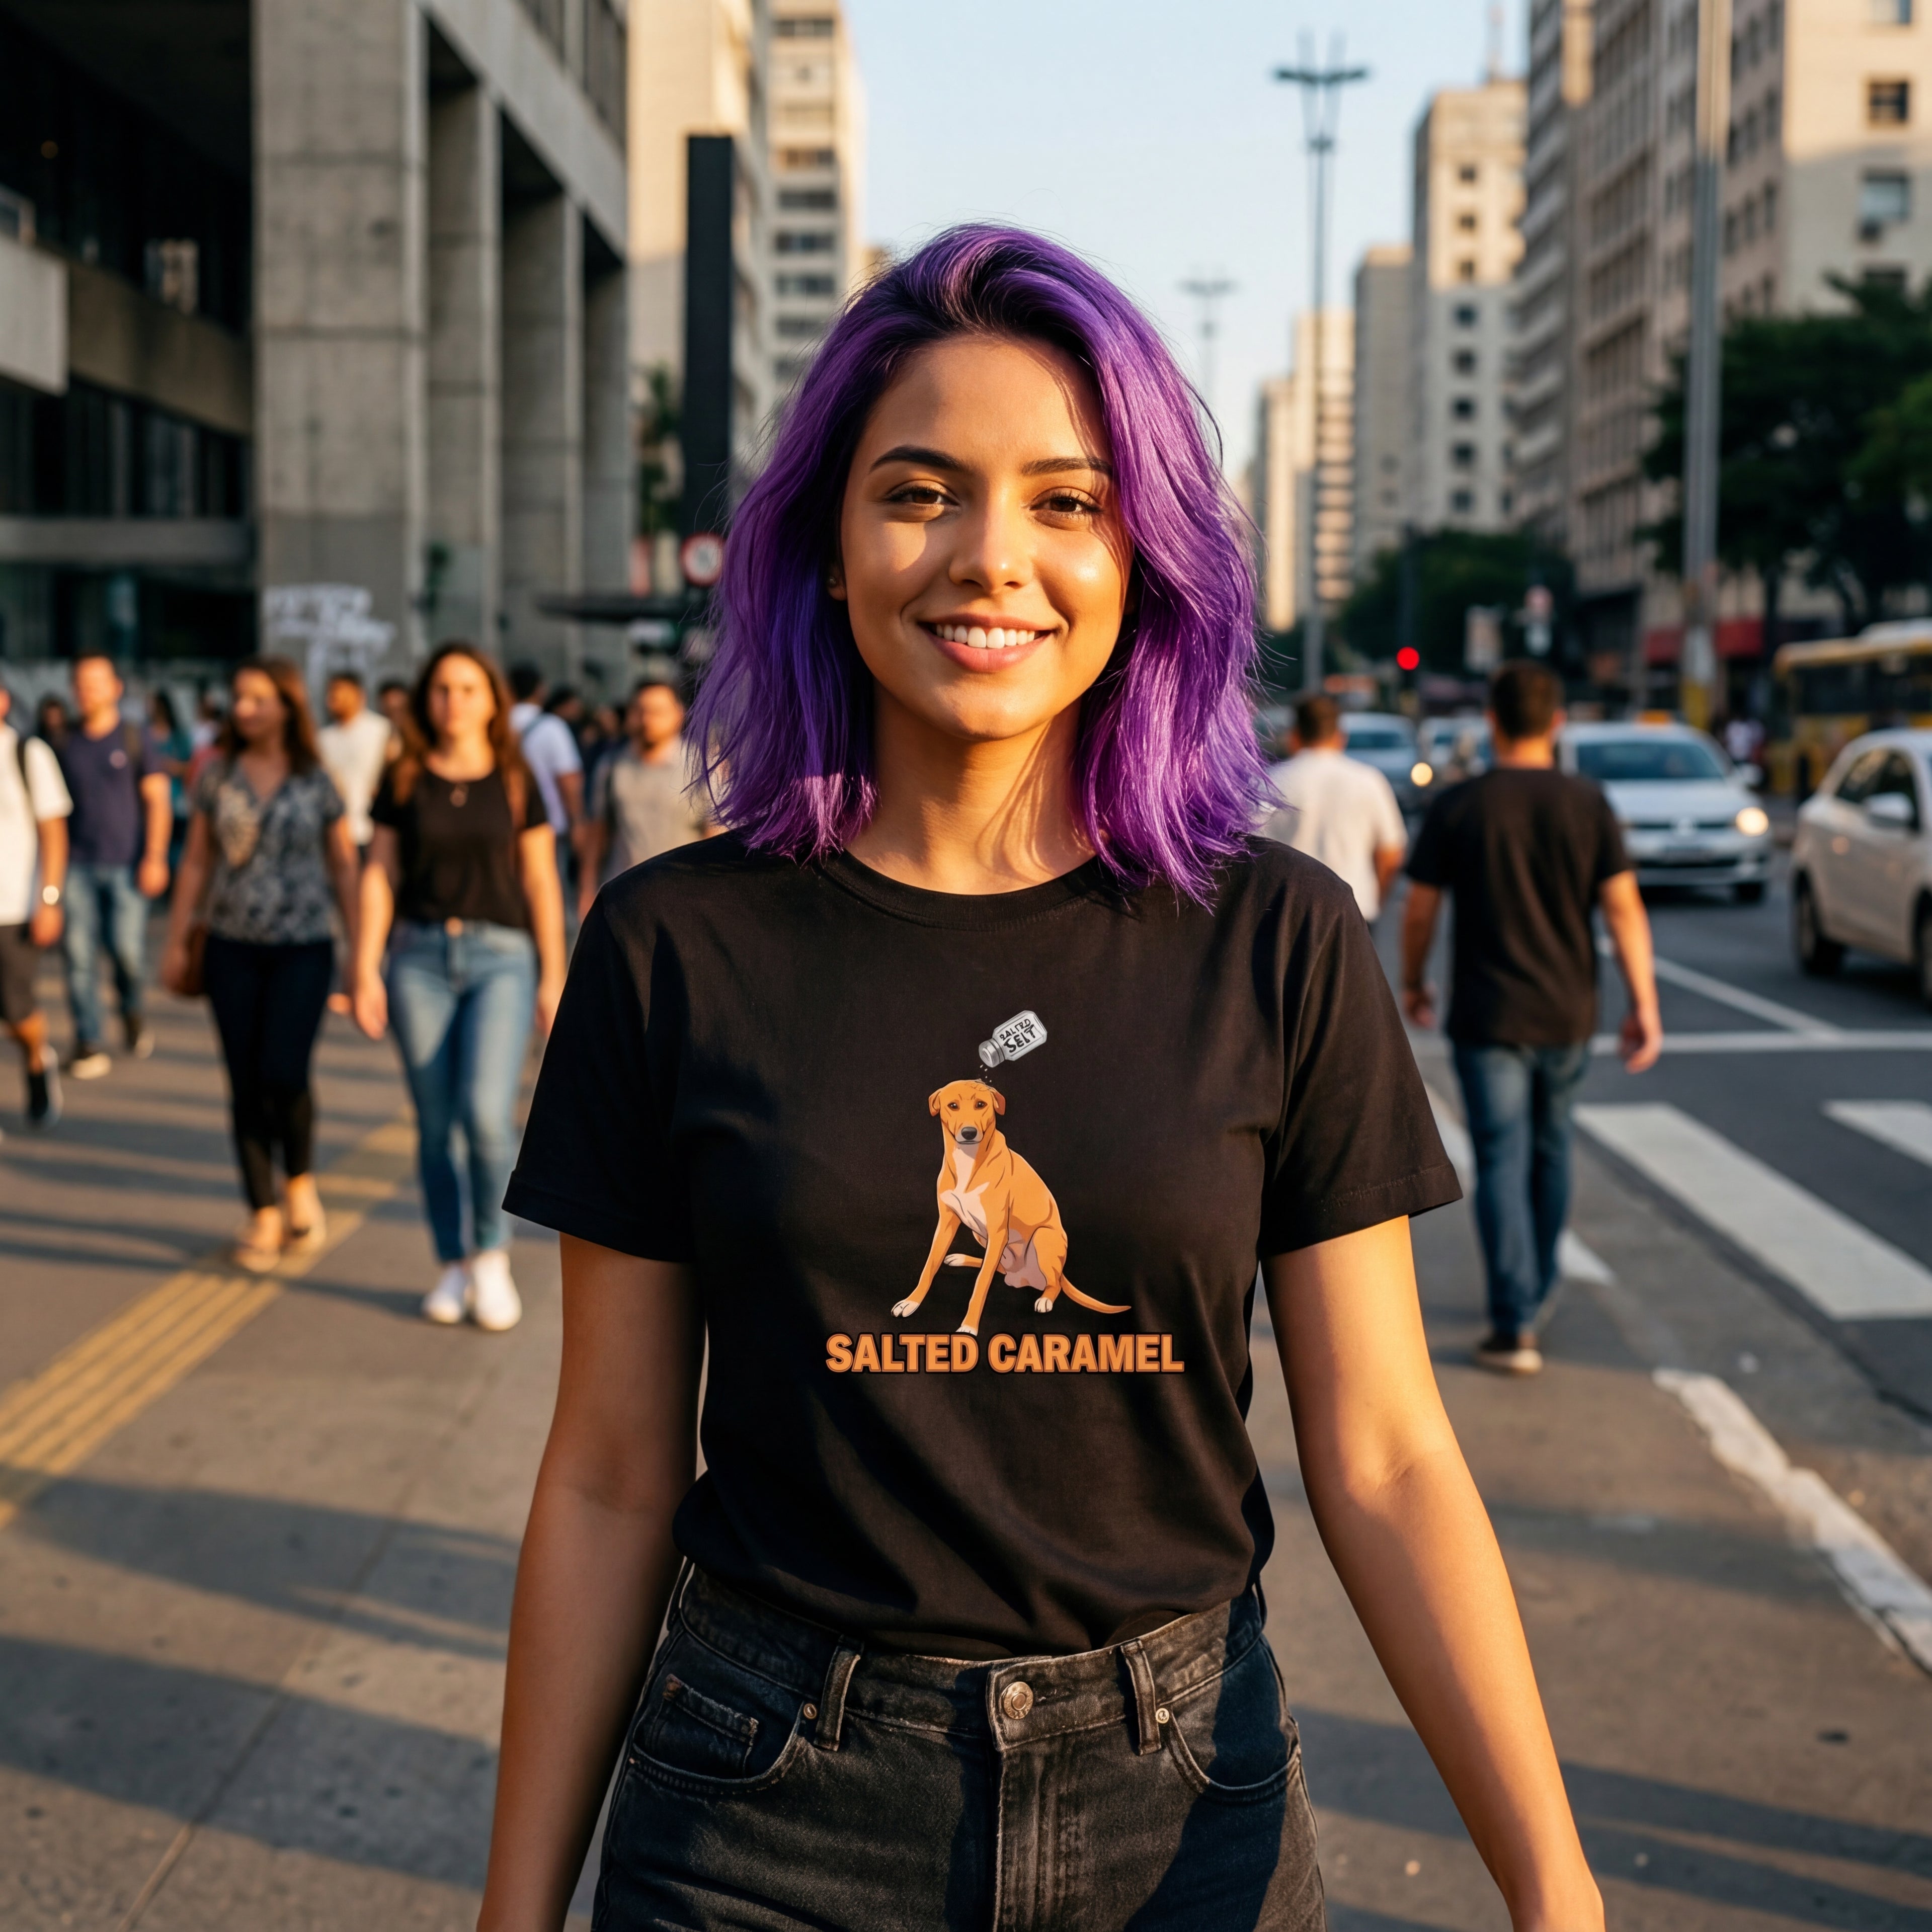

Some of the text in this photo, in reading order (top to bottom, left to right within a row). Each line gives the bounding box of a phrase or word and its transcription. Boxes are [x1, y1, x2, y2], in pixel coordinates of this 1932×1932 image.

[1004, 1024, 1035, 1053] SELT
[826, 1333, 1184, 1373] SALTED CARAMEL
